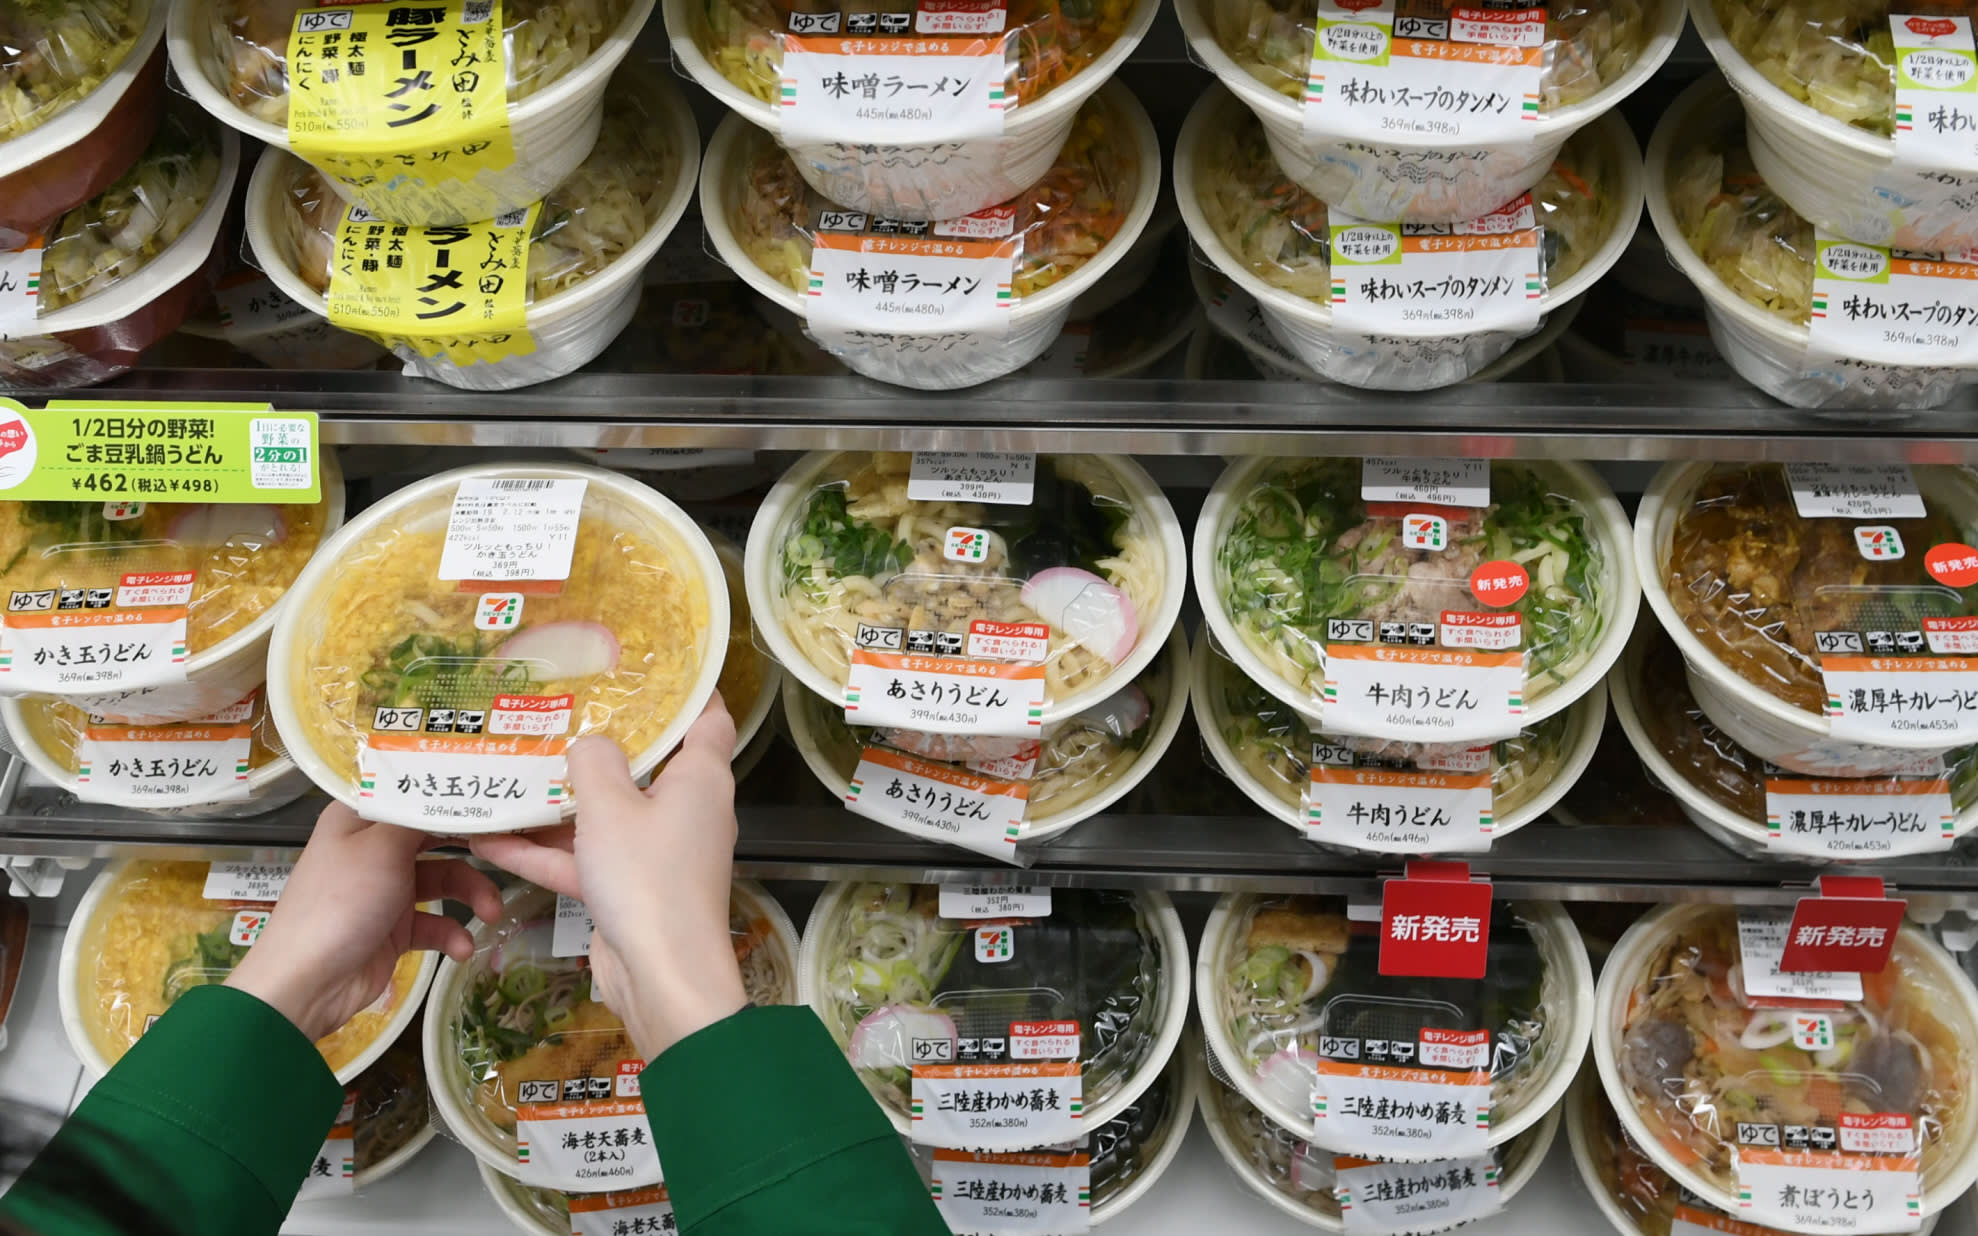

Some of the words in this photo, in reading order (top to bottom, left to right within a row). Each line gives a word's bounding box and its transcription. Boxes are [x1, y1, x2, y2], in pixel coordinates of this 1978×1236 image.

[305, 12, 348, 29] ゆで
[793, 15, 837, 31] ゆで
[1458, 11, 1540, 21] 電子レンジ専用
[1399, 19, 1445, 37] ゆで
[840, 41, 950, 53] 電子レンジで温める
[296, 36, 315, 90] にんにく
[822, 71, 972, 100] 味噌ラーメン
[1341, 77, 1511, 114] 味わいスープのタンメン
[823, 213, 863, 228] ゆで
[1340, 232, 1393, 242] 1/2日分以上の
[342, 226, 361, 276] にんにく
[1342, 243, 1391, 255] 野菜を使用
[1828, 259, 1878, 273] 野菜を使用
[846, 268, 981, 295] 味噌ラーメン
[1361, 274, 1514, 303] 味わいスープのタンメン
[72, 418, 214, 439] 1/2日分の野菜!
[66, 443, 223, 465] ごま豆乳鍋うどん
[256, 448, 304, 462] 2分の1
[126, 572, 193, 585] 電子レンジ専用
[1477, 575, 1523, 592] 新発売
[14, 593, 51, 609] ゆで
[51, 612, 143, 626] 電子レンジで温める
[1447, 614, 1516, 625] 電子レンジ専用
[861, 627, 899, 647] ゆで
[976, 623, 1044, 637] 電子レンジ専用
[1332, 621, 1371, 639] ゆで
[1819, 633, 1859, 650] ゆで
[34, 642, 153, 666] かき玉うどん
[1375, 650, 1473, 664] 電子レンジで温める
[901, 659, 996, 675] 電子レンジで温める
[1871, 660, 1968, 670] 電子レンジで温める
[887, 678, 1008, 708] あさりうどん
[1365, 682, 1478, 710] 牛肉うどん
[499, 698, 568, 709] 電子レンジ専用
[379, 709, 419, 729] ゆで
[504, 722, 554, 731] 手間いらず!
[418, 739, 517, 752] 電子レンジで温める
[1316, 746, 1351, 762] ゆで
[109, 758, 218, 778] かき玉うどん
[398, 774, 527, 800] かき玉うどん
[1356, 774, 1446, 786] 電子レンジで温める
[886, 778, 991, 821] あさりうどん
[1347, 801, 1451, 827] 牛肉うどん
[1790, 809, 1927, 834] 濃厚牛カレーうどん
[1391, 914, 1480, 942] 新発売
[1794, 925, 1887, 947] 新発売
[1015, 1024, 1075, 1034] 電子レンジ専用
[1424, 1032, 1485, 1043] 電子レンジ専用
[916, 1041, 950, 1059] ゆで
[1322, 1038, 1357, 1057] ゆで
[522, 1085, 555, 1100] ゆで
[937, 1088, 1061, 1113] 三陸産わかめ蕎麦
[1340, 1096, 1467, 1125] 三陸産わかめ蕎麦
[1843, 1116, 1906, 1127] 電子レンジ専用
[562, 1127, 648, 1150] 海老天蕎麦
[1740, 1125, 1777, 1144] ゆで
[584, 1150, 625, 1164] (2本入)
[953, 1179, 1069, 1205] 三陸産わかめ蕎麦
[1363, 1167, 1477, 1203] 三陸産わかめ蕎麦
[1779, 1184, 1875, 1210] 煮ぼうとう
